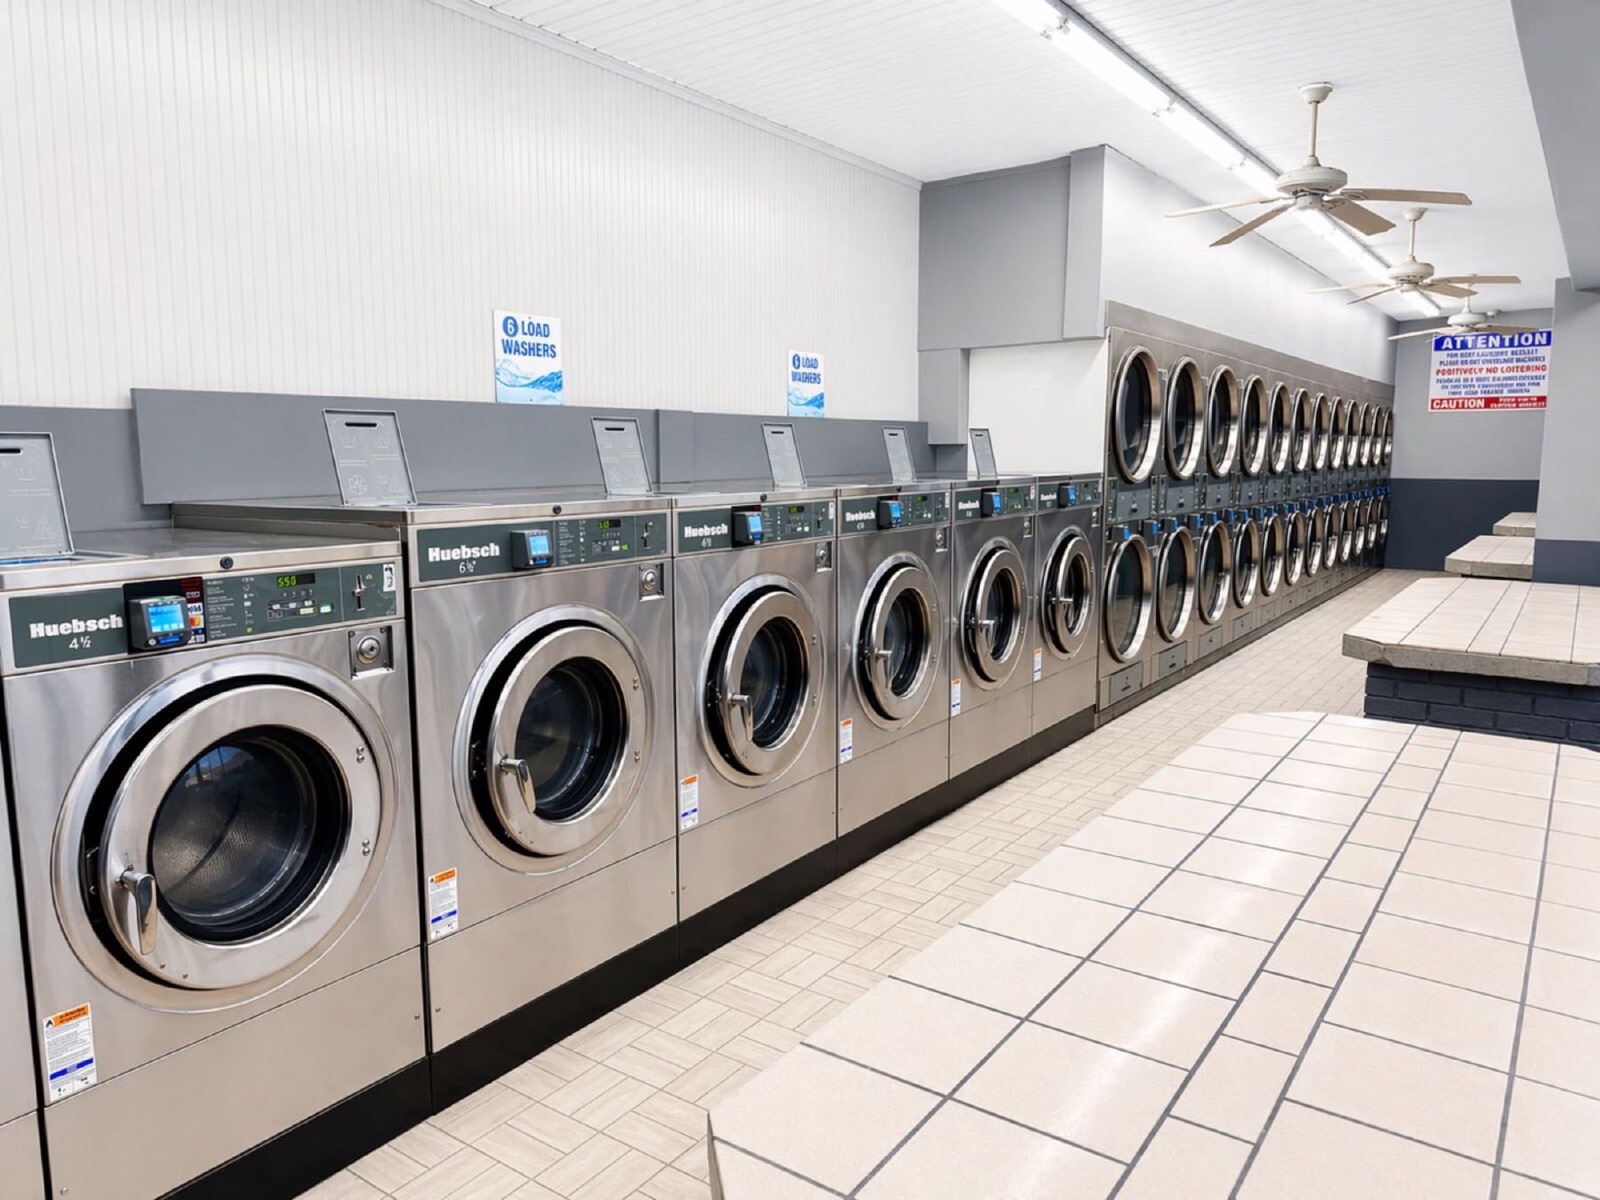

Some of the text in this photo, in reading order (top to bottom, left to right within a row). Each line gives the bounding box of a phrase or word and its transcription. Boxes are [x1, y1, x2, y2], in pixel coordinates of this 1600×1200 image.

[521, 320, 550, 338] LOAD
[501, 338, 557, 359] WASHERS
[1441, 332, 1548, 350] ATTENTION
[1486, 366, 1498, 374] NO
[1433, 398, 1486, 409] CAUTION
[684, 523, 728, 538] Huebsch
[428, 542, 500, 562] Huebsch
[29, 614, 123, 639] Huebsch
